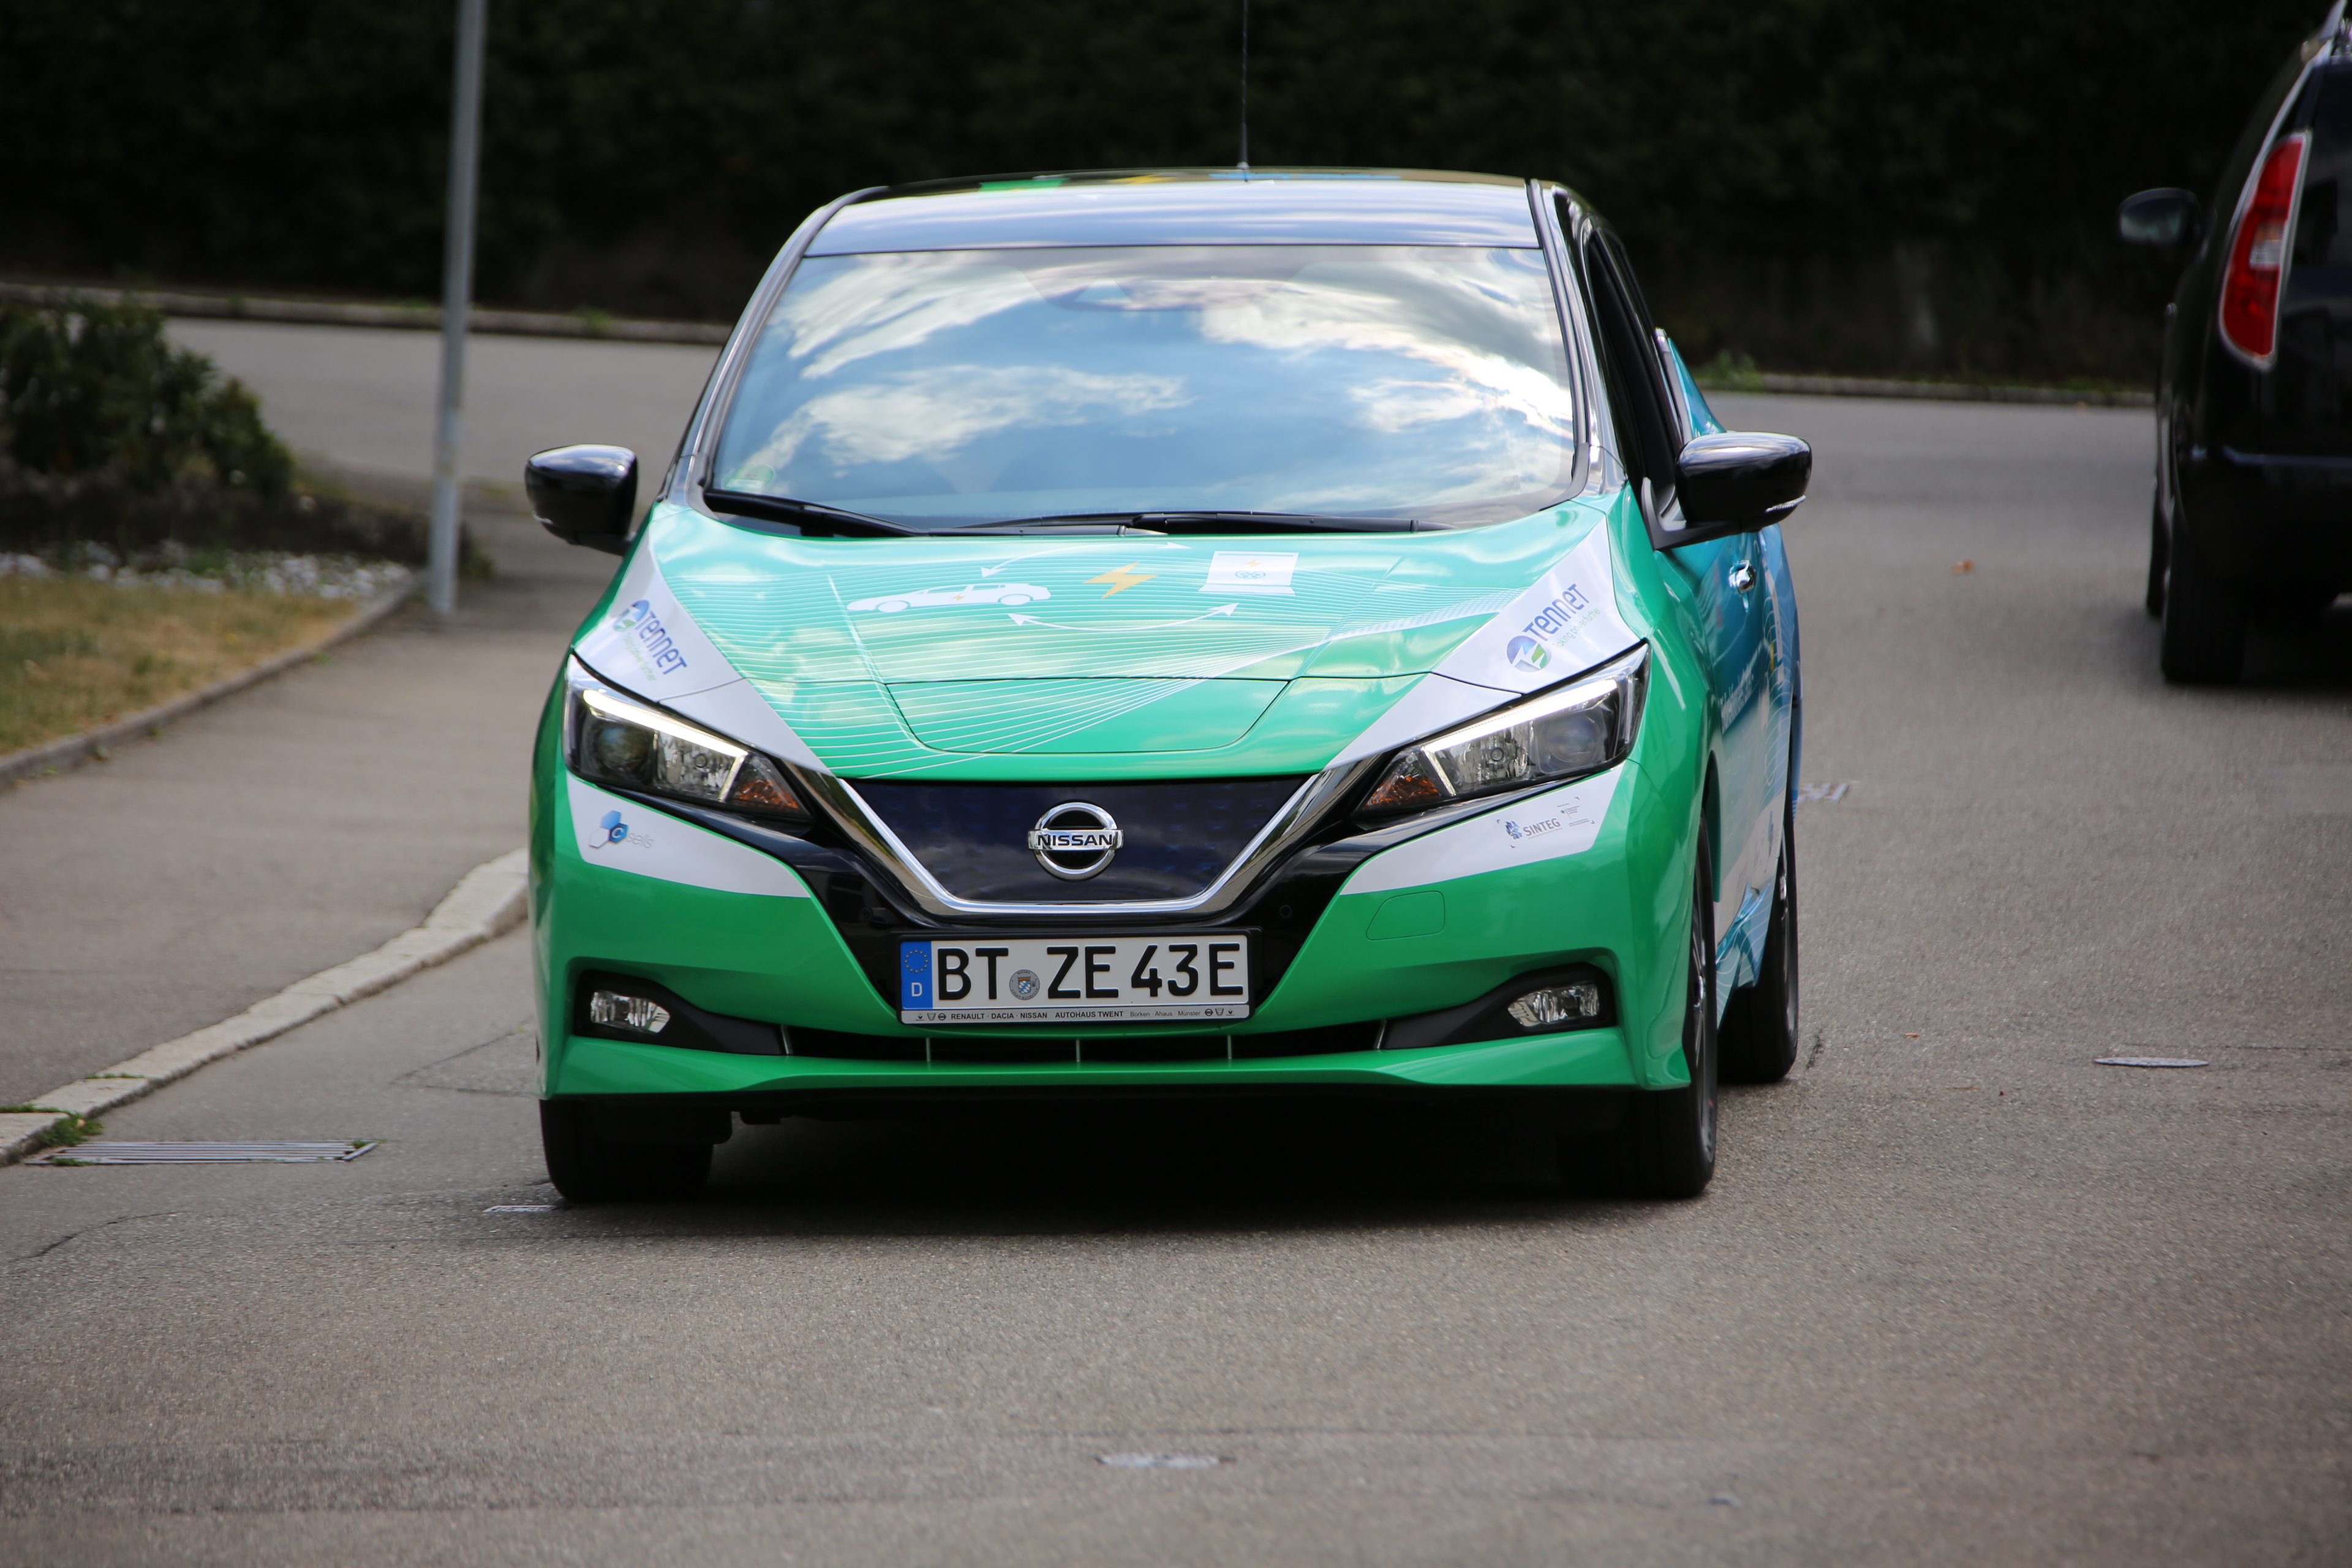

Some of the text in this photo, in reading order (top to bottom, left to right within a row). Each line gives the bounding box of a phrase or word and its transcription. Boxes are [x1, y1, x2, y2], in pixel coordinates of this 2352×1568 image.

[1551, 632, 1576, 648] Taking
[1523, 818, 1561, 837] SINTEG
[1038, 834, 1112, 846] NISSAN
[937, 943, 1243, 1000] BT ZE 43E
[911, 982, 922, 997] D
